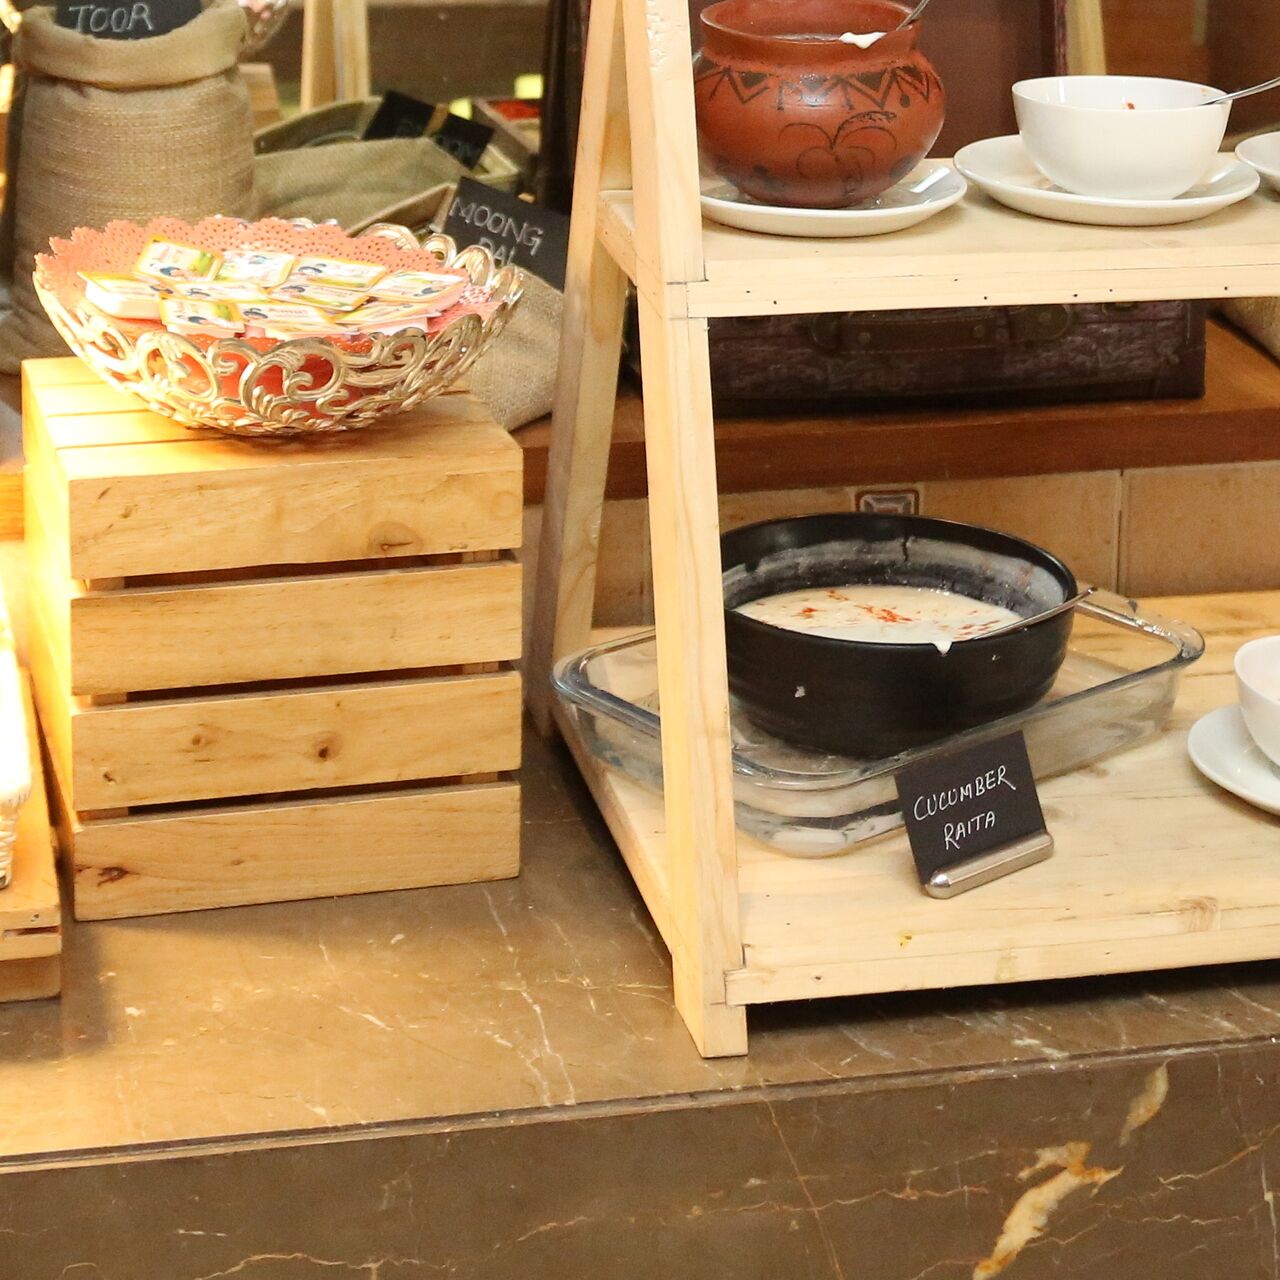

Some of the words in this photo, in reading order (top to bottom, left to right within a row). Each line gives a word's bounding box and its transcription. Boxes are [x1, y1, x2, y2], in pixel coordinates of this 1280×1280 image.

[68, 1, 154, 34] TOOR
[449, 196, 545, 257] MOONG
[913, 764, 1017, 822] CUCUMBER
[943, 810, 997, 851] RAITA
